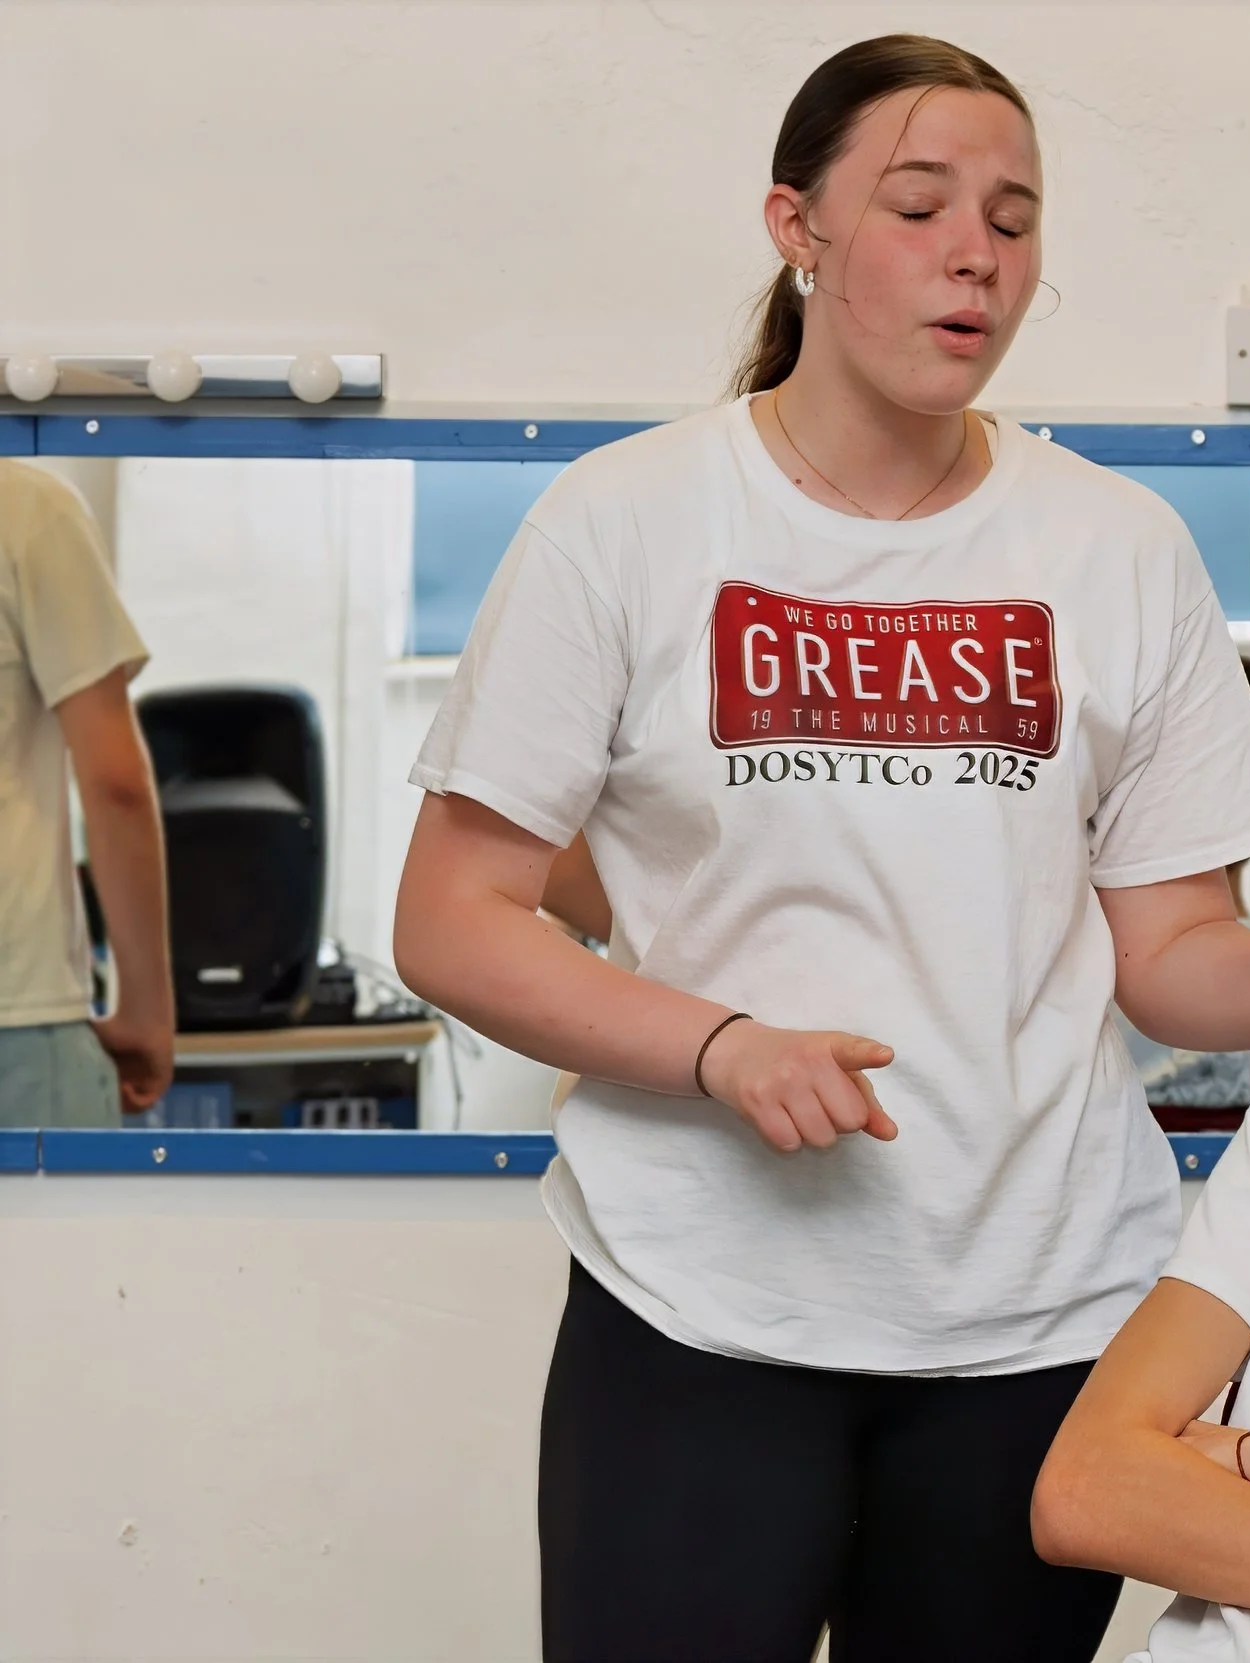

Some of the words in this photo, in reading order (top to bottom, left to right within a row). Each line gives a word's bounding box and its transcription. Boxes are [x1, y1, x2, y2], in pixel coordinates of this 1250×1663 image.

[784, 605, 814, 627] WE
[826, 612, 852, 631] GO
[864, 613, 978, 633] TOGETHER
[743, 623, 1037, 708] GREASE
[751, 709, 772, 730] 19
[791, 708, 841, 730] THE
[863, 713, 988, 735] MUSICAL
[1017, 718, 1038, 740] 59
[725, 750, 933, 787] DOSYTCo
[954, 752, 1040, 792] 2025
